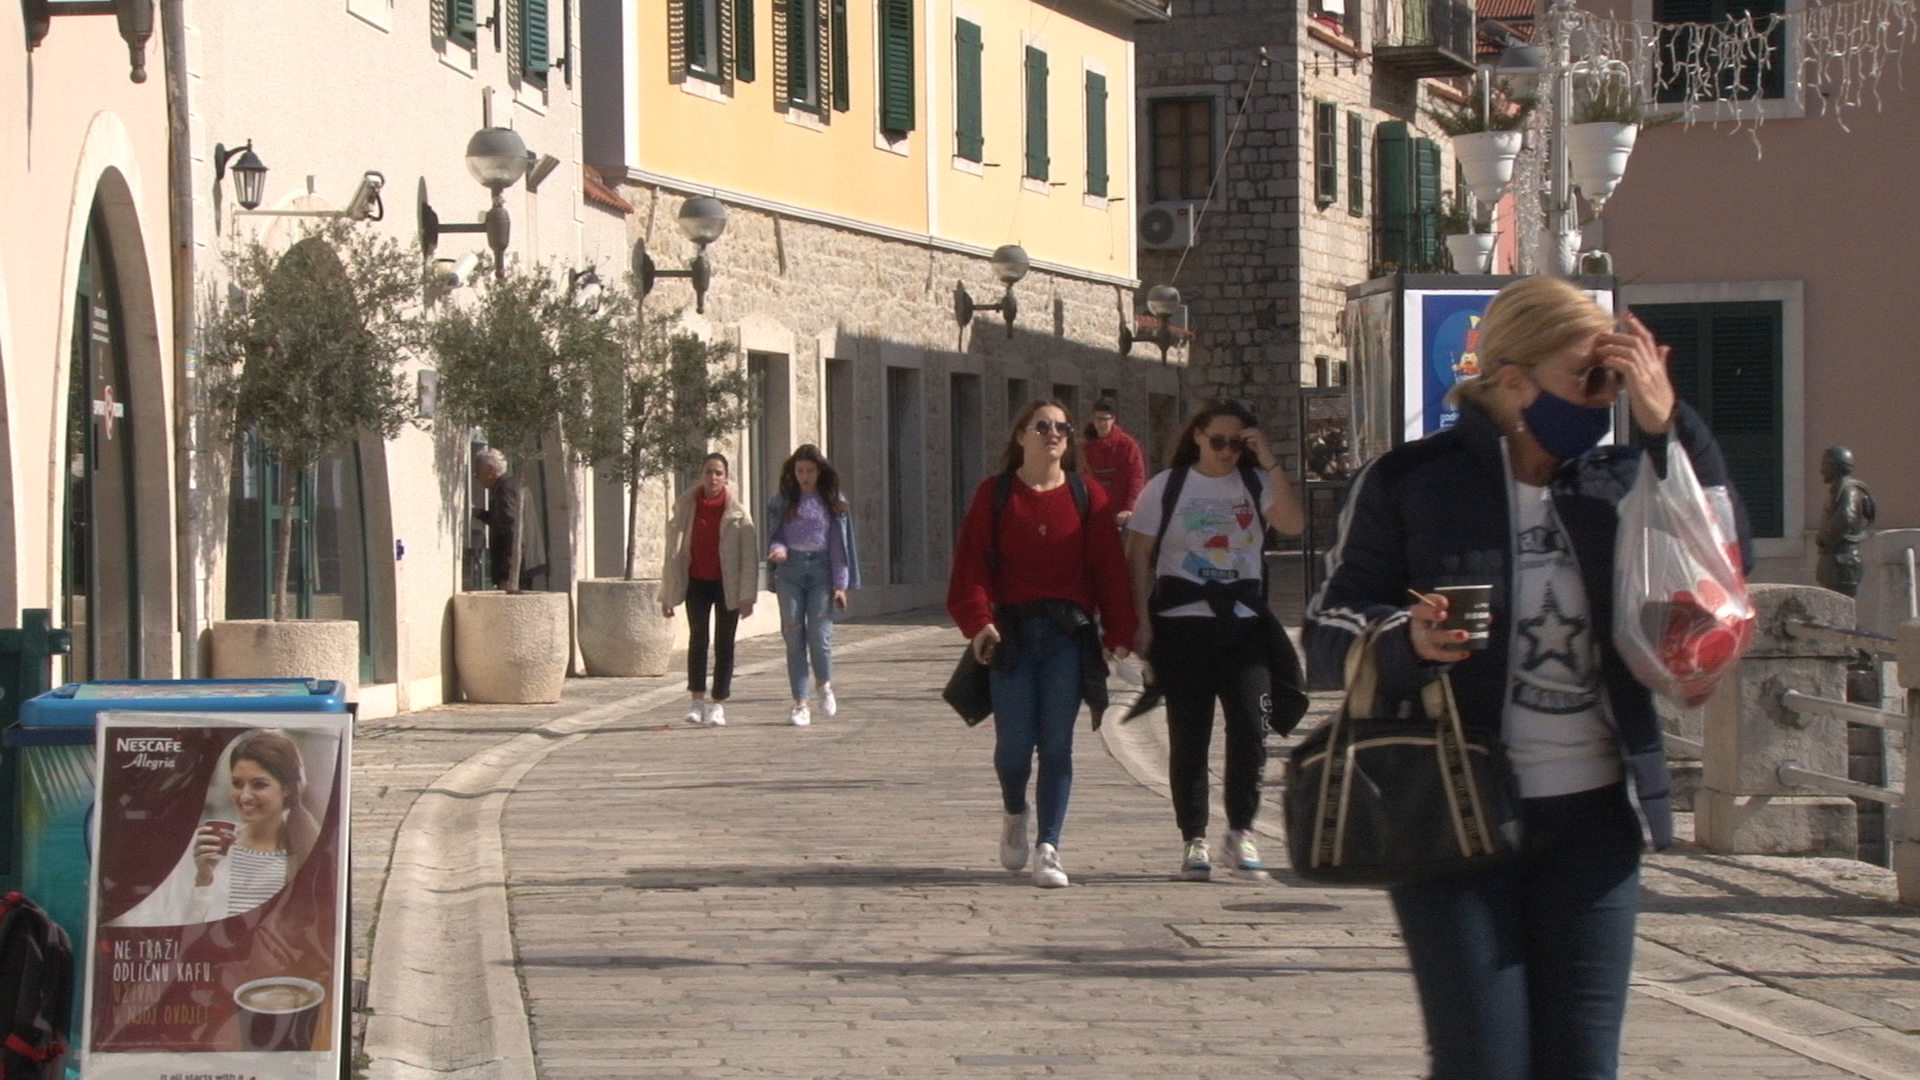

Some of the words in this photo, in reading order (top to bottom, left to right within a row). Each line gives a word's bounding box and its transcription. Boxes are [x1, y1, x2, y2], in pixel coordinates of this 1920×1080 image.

[122, 753, 176, 771] Alegria
[114, 940, 131, 960] NE
[139, 938, 179, 960] TRAŽI
[113, 960, 169, 982] ODLIČNU
